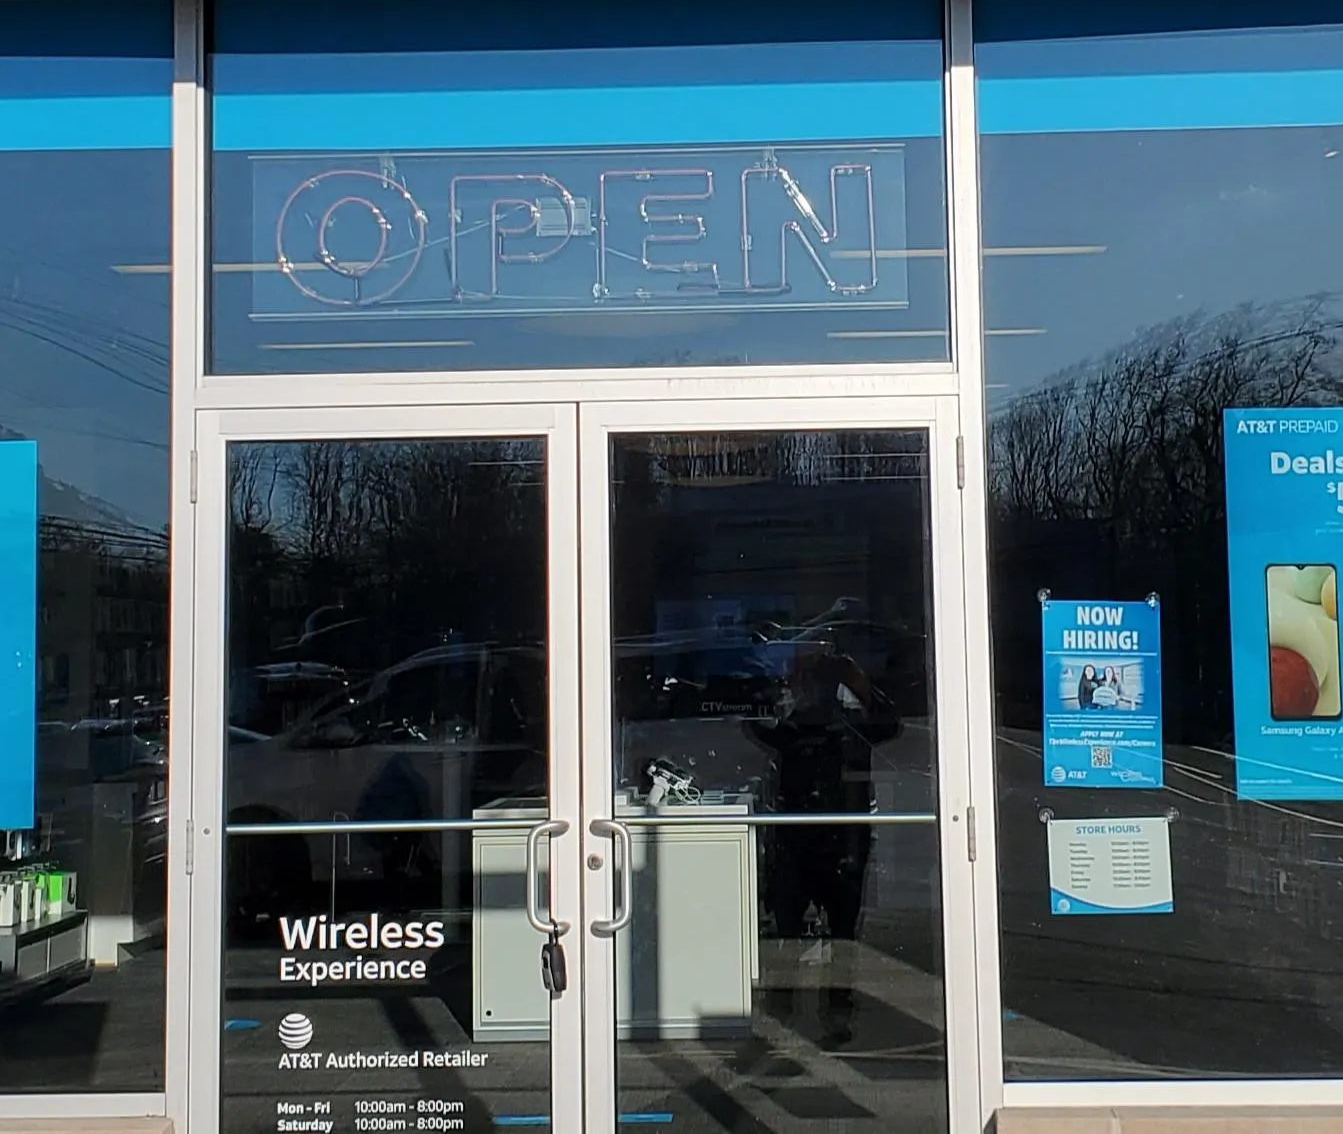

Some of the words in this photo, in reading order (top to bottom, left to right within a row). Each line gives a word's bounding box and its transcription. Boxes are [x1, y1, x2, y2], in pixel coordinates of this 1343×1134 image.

[274, 161, 881, 308] OPEN
[1237, 420, 1277, 434] AT&T
[1280, 420, 1338, 433] PREPAID
[1077, 606, 1123, 625] NOW
[1063, 630, 1139, 650] HIRING!
[1261, 726, 1304, 736] Samsung
[1304, 726, 1336, 736] Galaxy
[1067, 770, 1088, 780] AT&T
[1075, 825, 1108, 835] STORE
[1108, 824, 1142, 834] HOURS
[280, 913, 444, 950] Wireless
[281, 955, 426, 986] Experience
[279, 1053, 322, 1069] AT&T
[326, 1051, 418, 1068] Authorized
[423, 1050, 488, 1066] Retailer
[278, 1102, 304, 1114] Mon
[315, 1101, 330, 1114] Fri
[355, 1101, 406, 1113] 10:00am
[417, 1100, 463, 1114] 8:00pm
[278, 1119, 333, 1133] Saturday
[355, 1118, 405, 1130] 10:00am
[417, 1117, 463, 1132] 8:00pm
